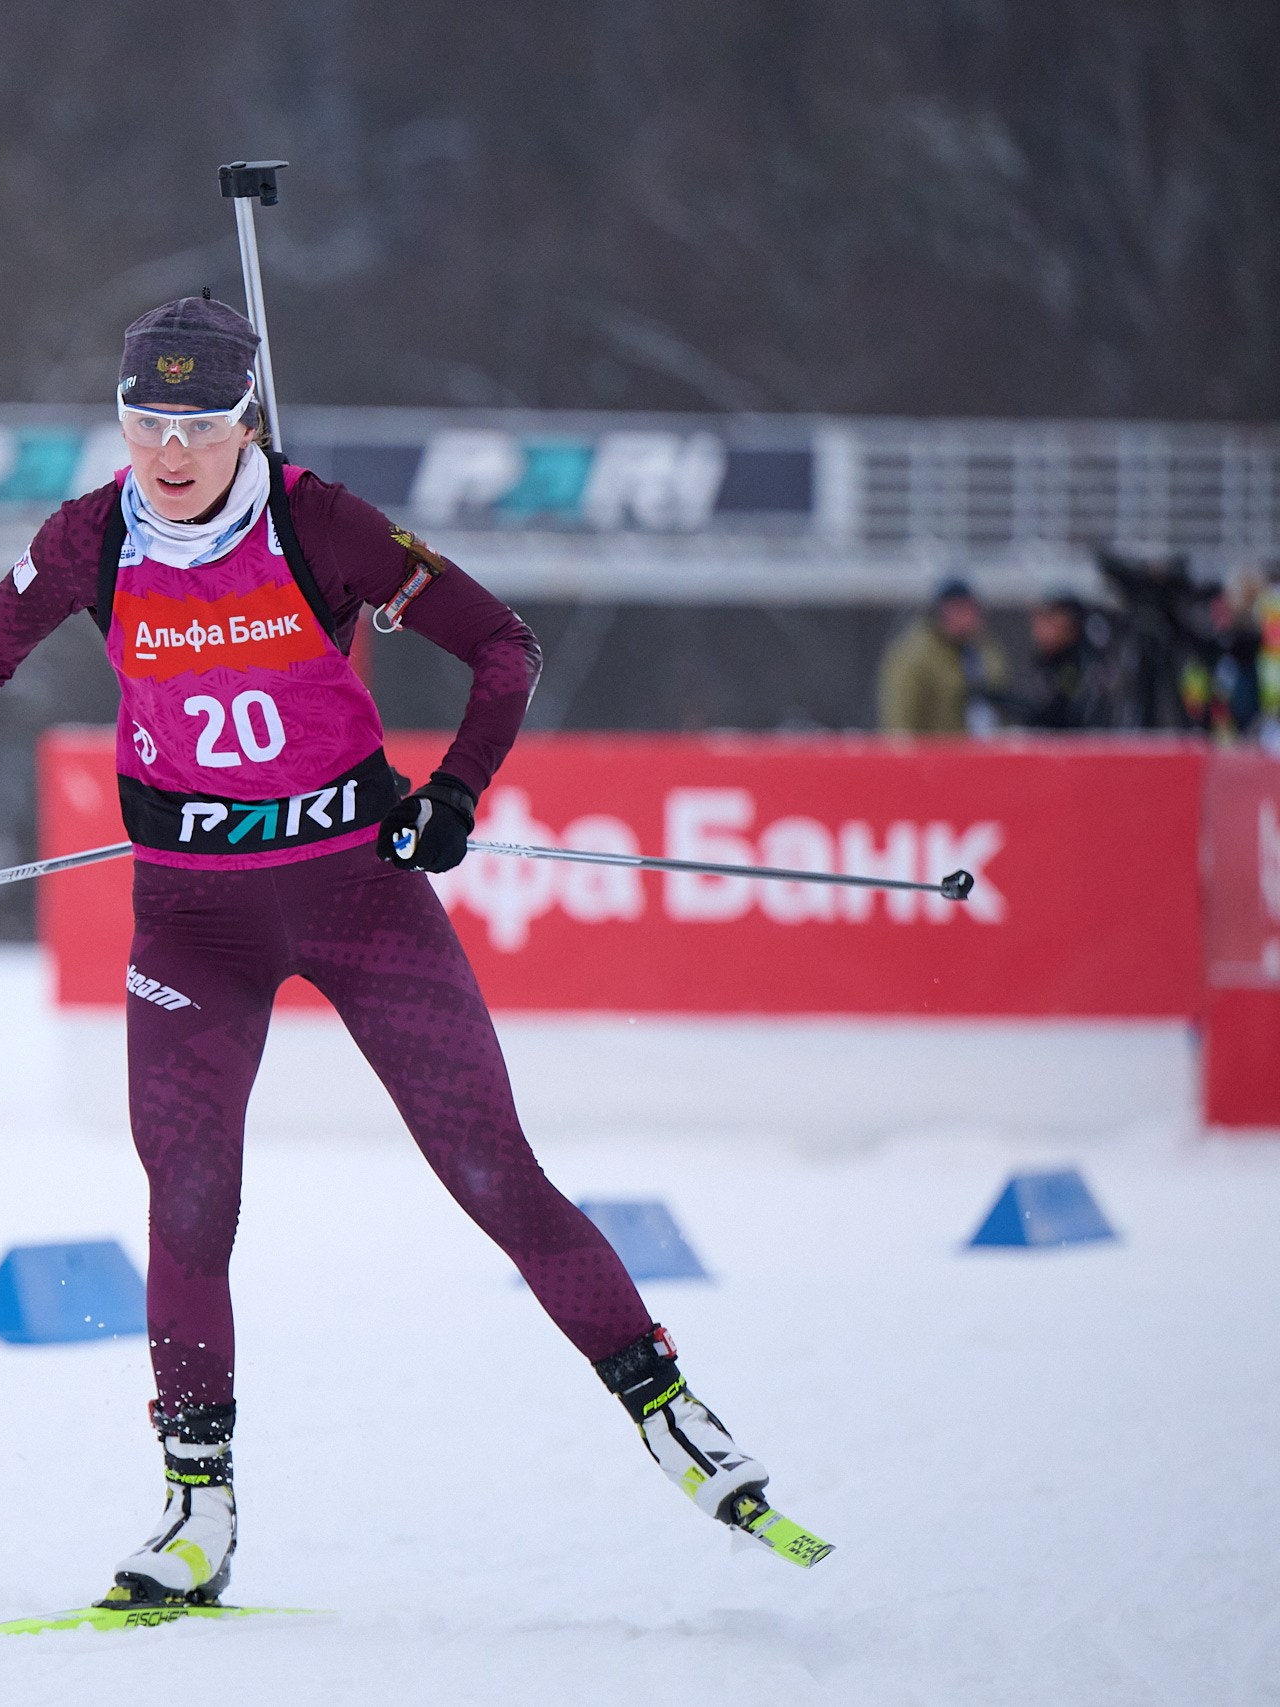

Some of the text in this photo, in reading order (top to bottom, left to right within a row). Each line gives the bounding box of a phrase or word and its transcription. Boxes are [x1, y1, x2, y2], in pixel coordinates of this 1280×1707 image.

[135, 613, 302, 653] Альфа Банк
[183, 690, 286, 768] 20
[178, 779, 358, 845] PARI
[660, 785, 1008, 925] Банк
